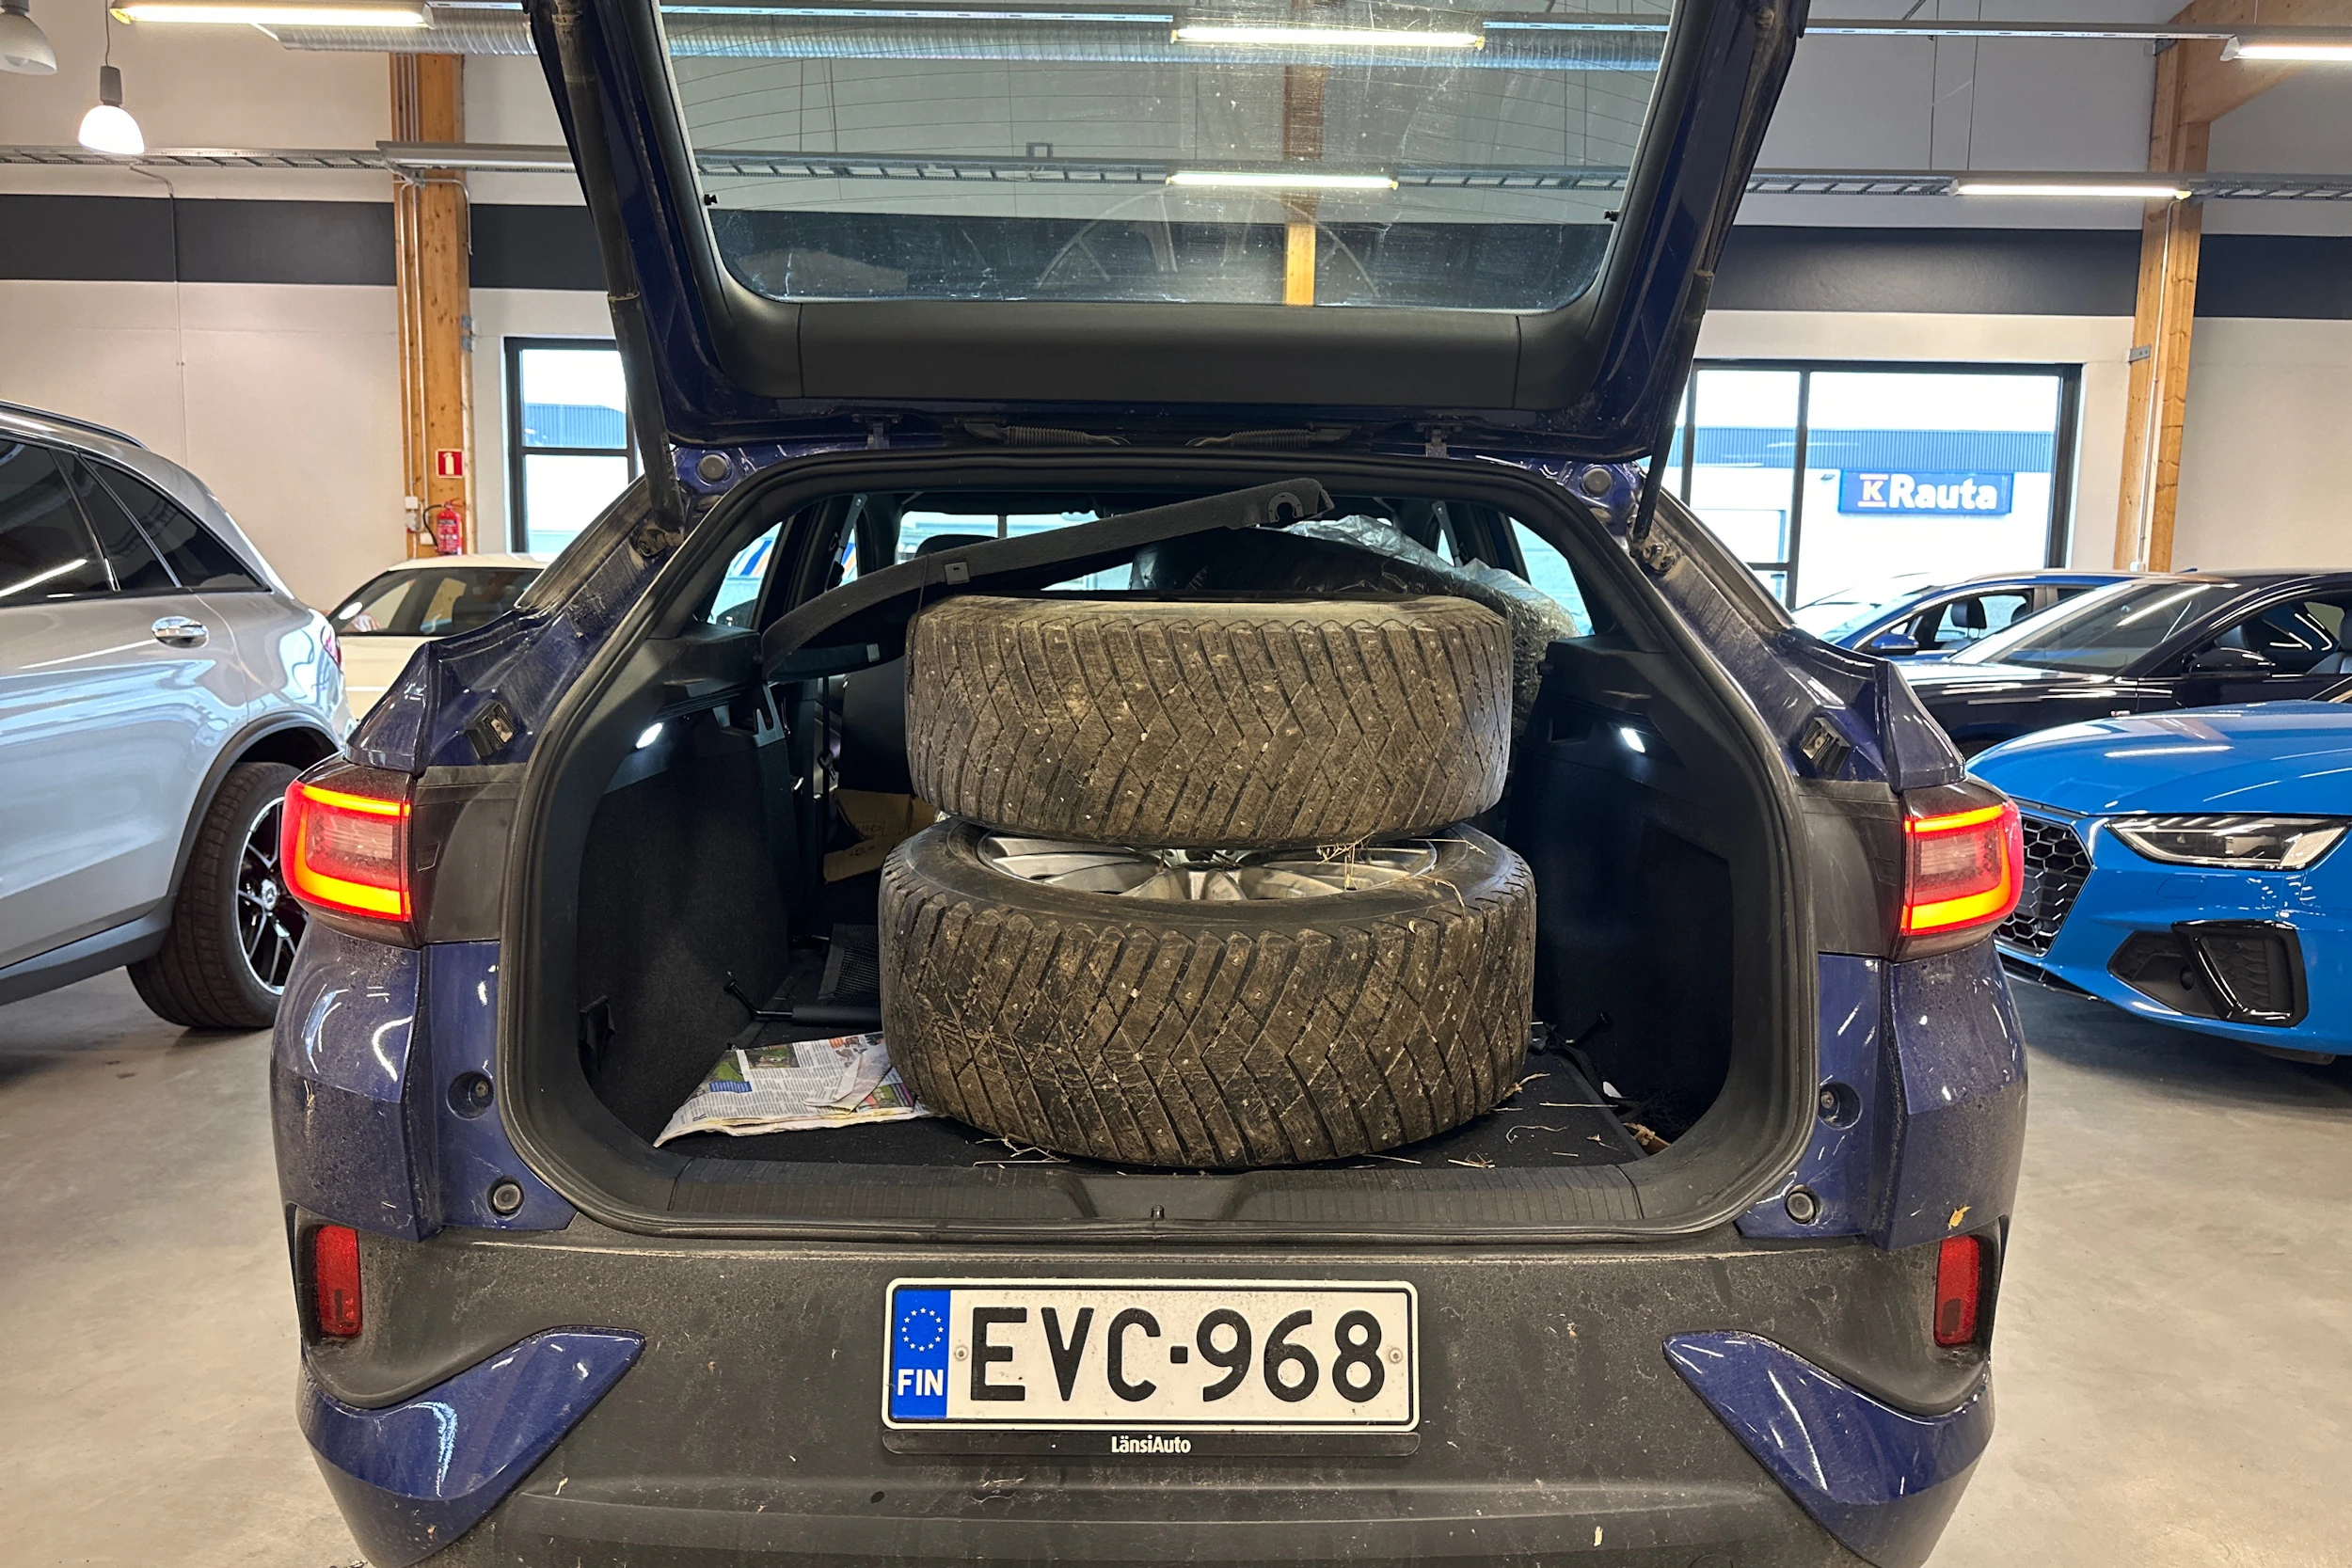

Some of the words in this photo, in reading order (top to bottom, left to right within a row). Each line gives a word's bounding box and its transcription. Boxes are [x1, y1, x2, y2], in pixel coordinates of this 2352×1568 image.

[1888, 473, 1997, 510] Rauta
[970, 1307, 1386, 1402] EVC-968
[897, 1369, 944, 1397] FIN
[1111, 1433, 1192, 1453] LänsiAuto
